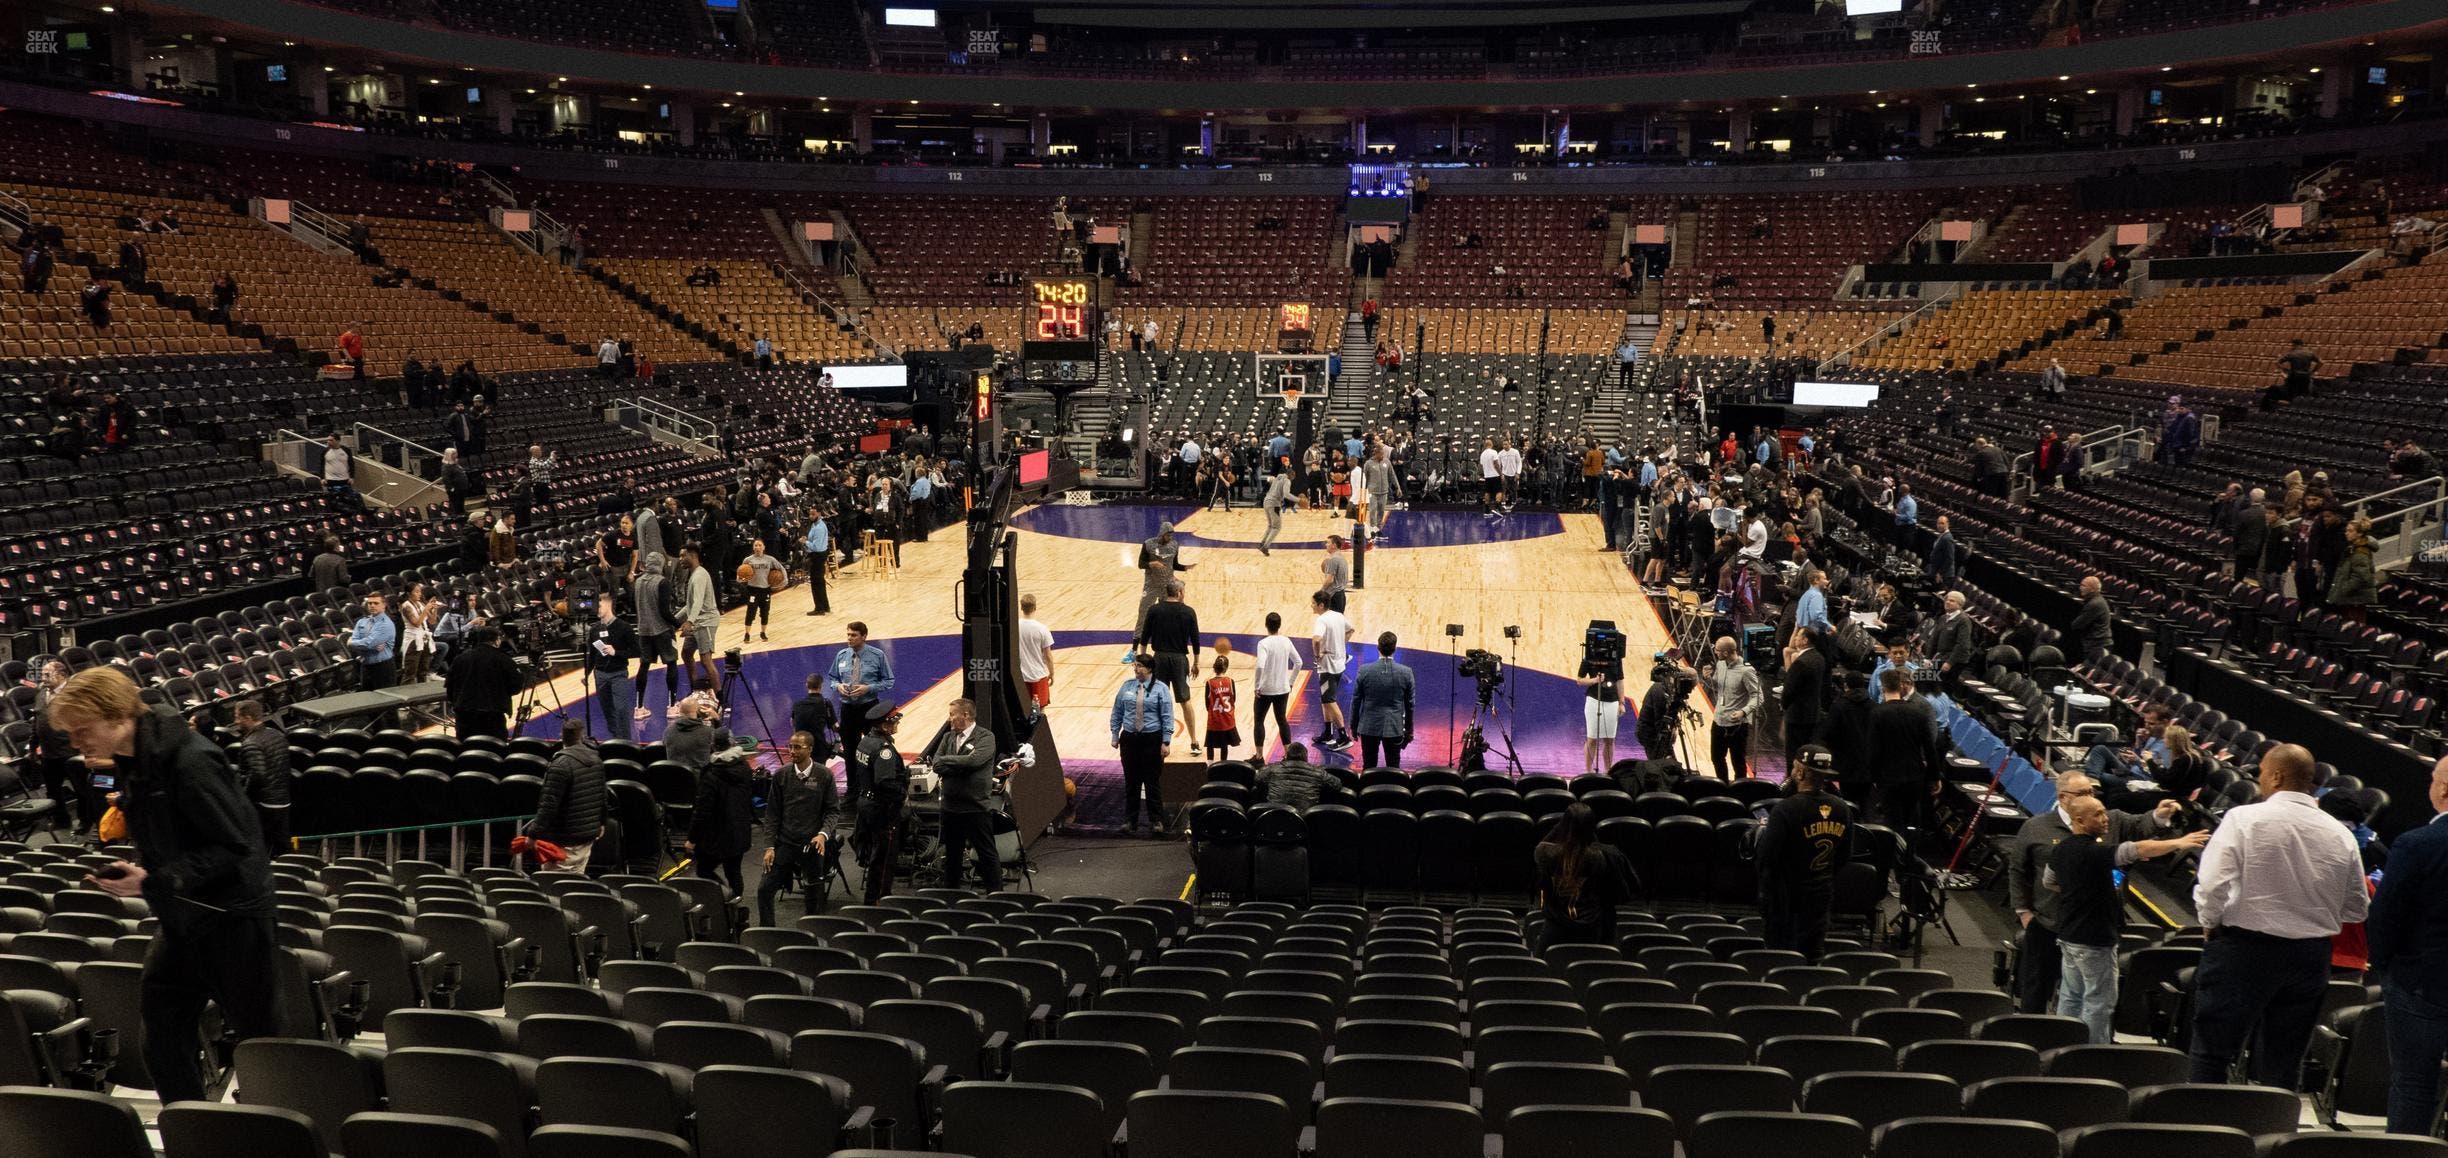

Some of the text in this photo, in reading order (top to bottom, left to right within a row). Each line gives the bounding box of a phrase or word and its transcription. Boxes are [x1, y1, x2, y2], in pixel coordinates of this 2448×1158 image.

[276, 128, 291, 140] 110
[2179, 149, 2195, 159] 116
[605, 158, 618, 168] 111
[948, 172, 962, 180] 112
[1258, 173, 1273, 182] 113
[1513, 172, 1527, 181] 114
[1809, 168, 1825, 177] 115
[1039, 305, 1080, 337] 24
[1285, 314, 1306, 329] 24
[1213, 695, 1232, 713] 43
[1803, 821, 1846, 839] LEONARD
[1810, 839, 1833, 871] 2
